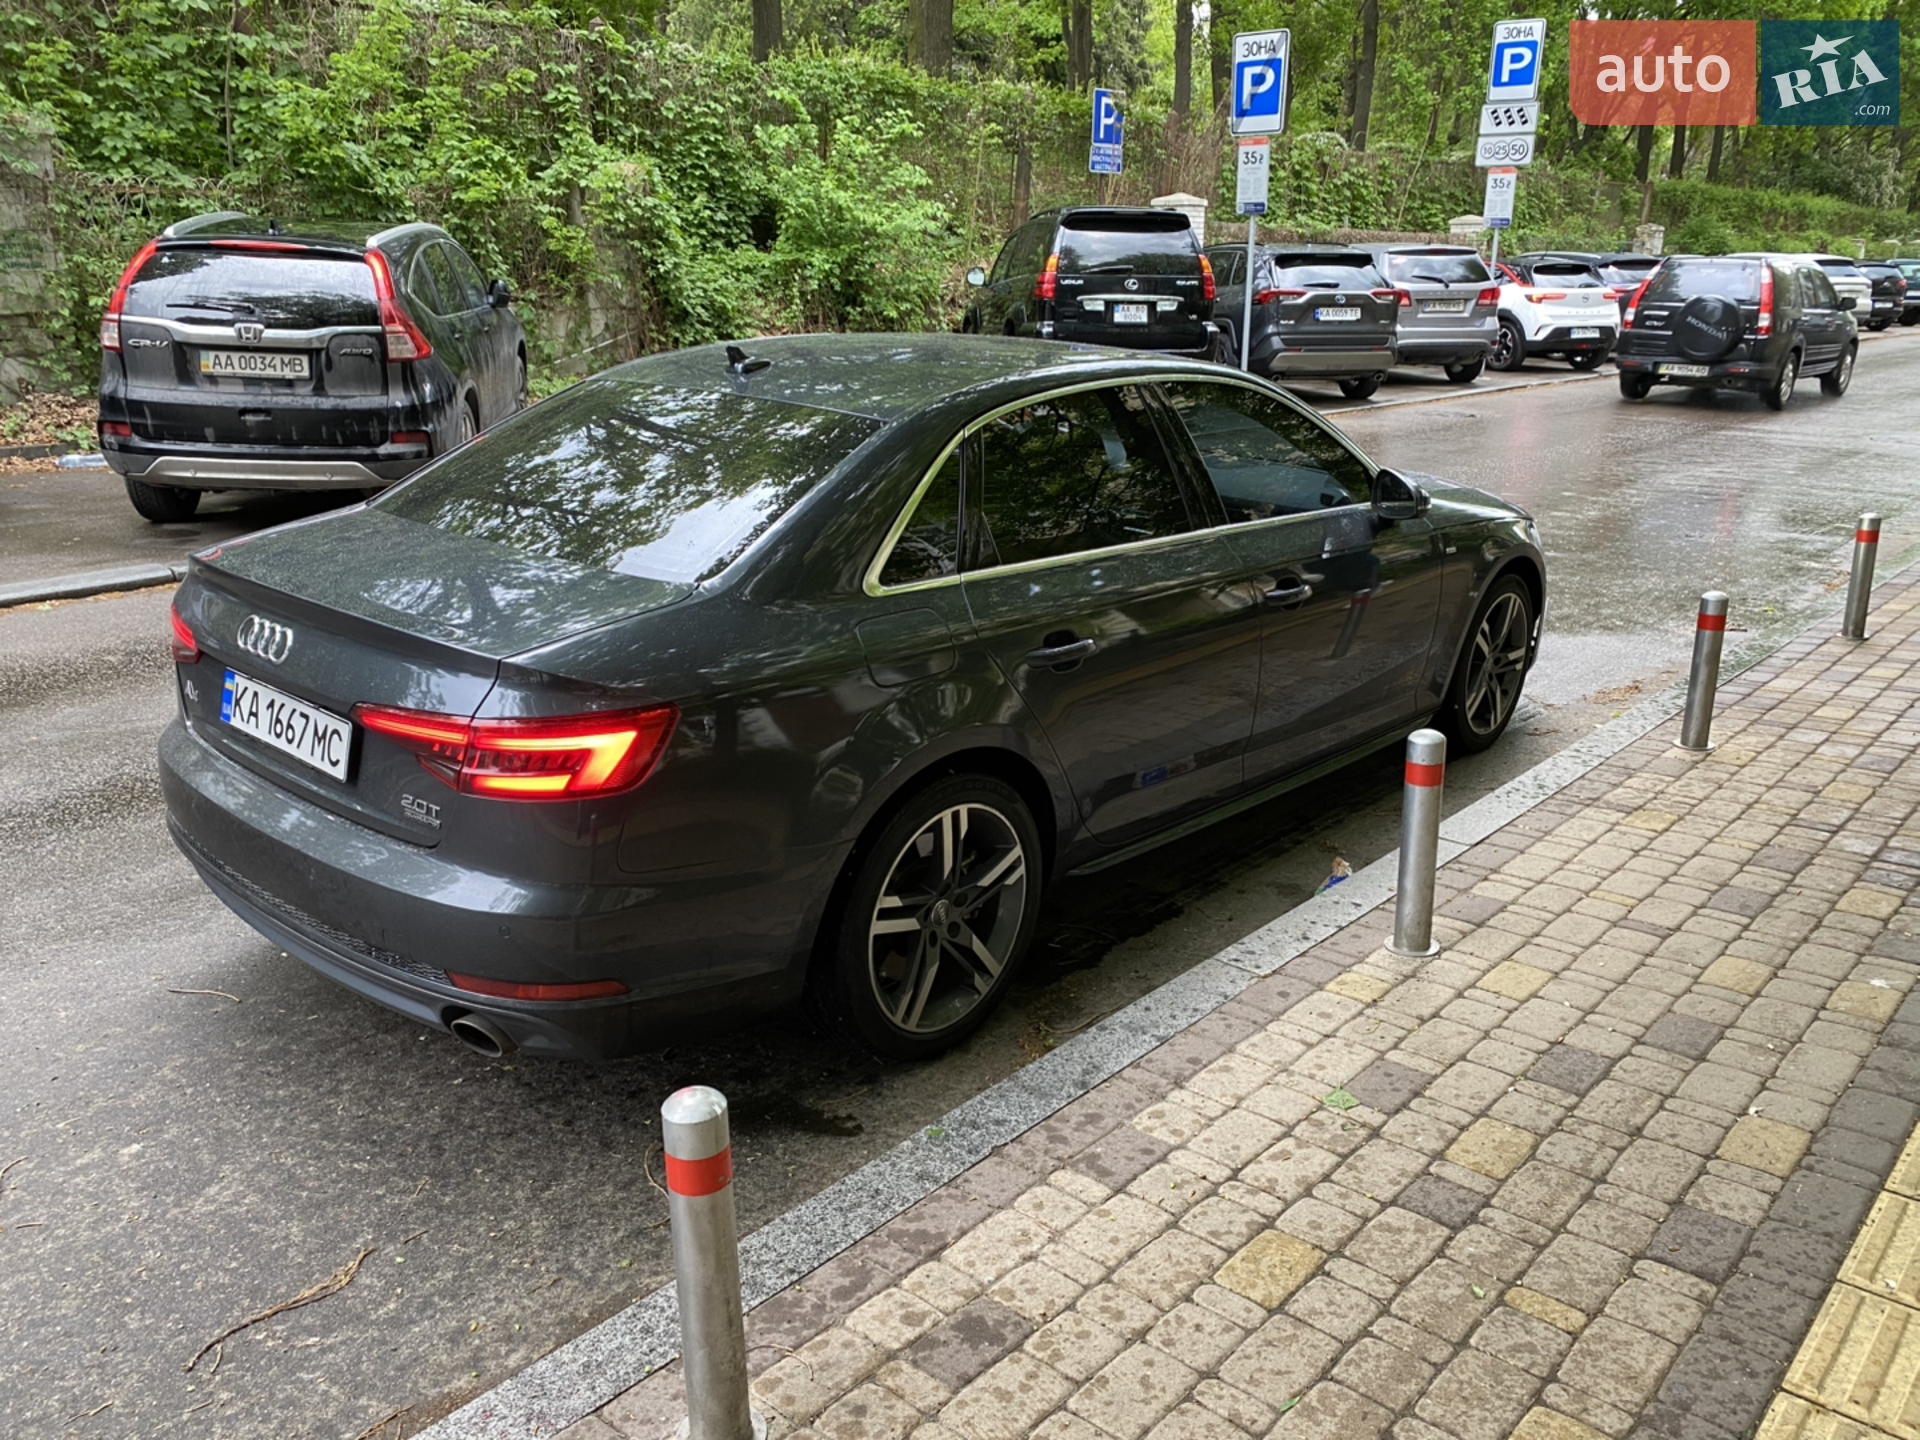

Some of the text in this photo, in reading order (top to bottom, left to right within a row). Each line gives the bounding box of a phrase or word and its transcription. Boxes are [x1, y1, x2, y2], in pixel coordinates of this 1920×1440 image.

[1503, 26, 1534, 39] ЗОНА
[1242, 39, 1277, 58] ЗОНА
[1501, 46, 1533, 83] P
[1242, 65, 1276, 110] P
[1511, 143, 1525, 156] 50
[1685, 315, 1723, 339] HONDA
[127, 338, 169, 349] CR-V
[212, 354, 305, 374] AA 0034 MB
[232, 682, 343, 768] KA 1667 MC
